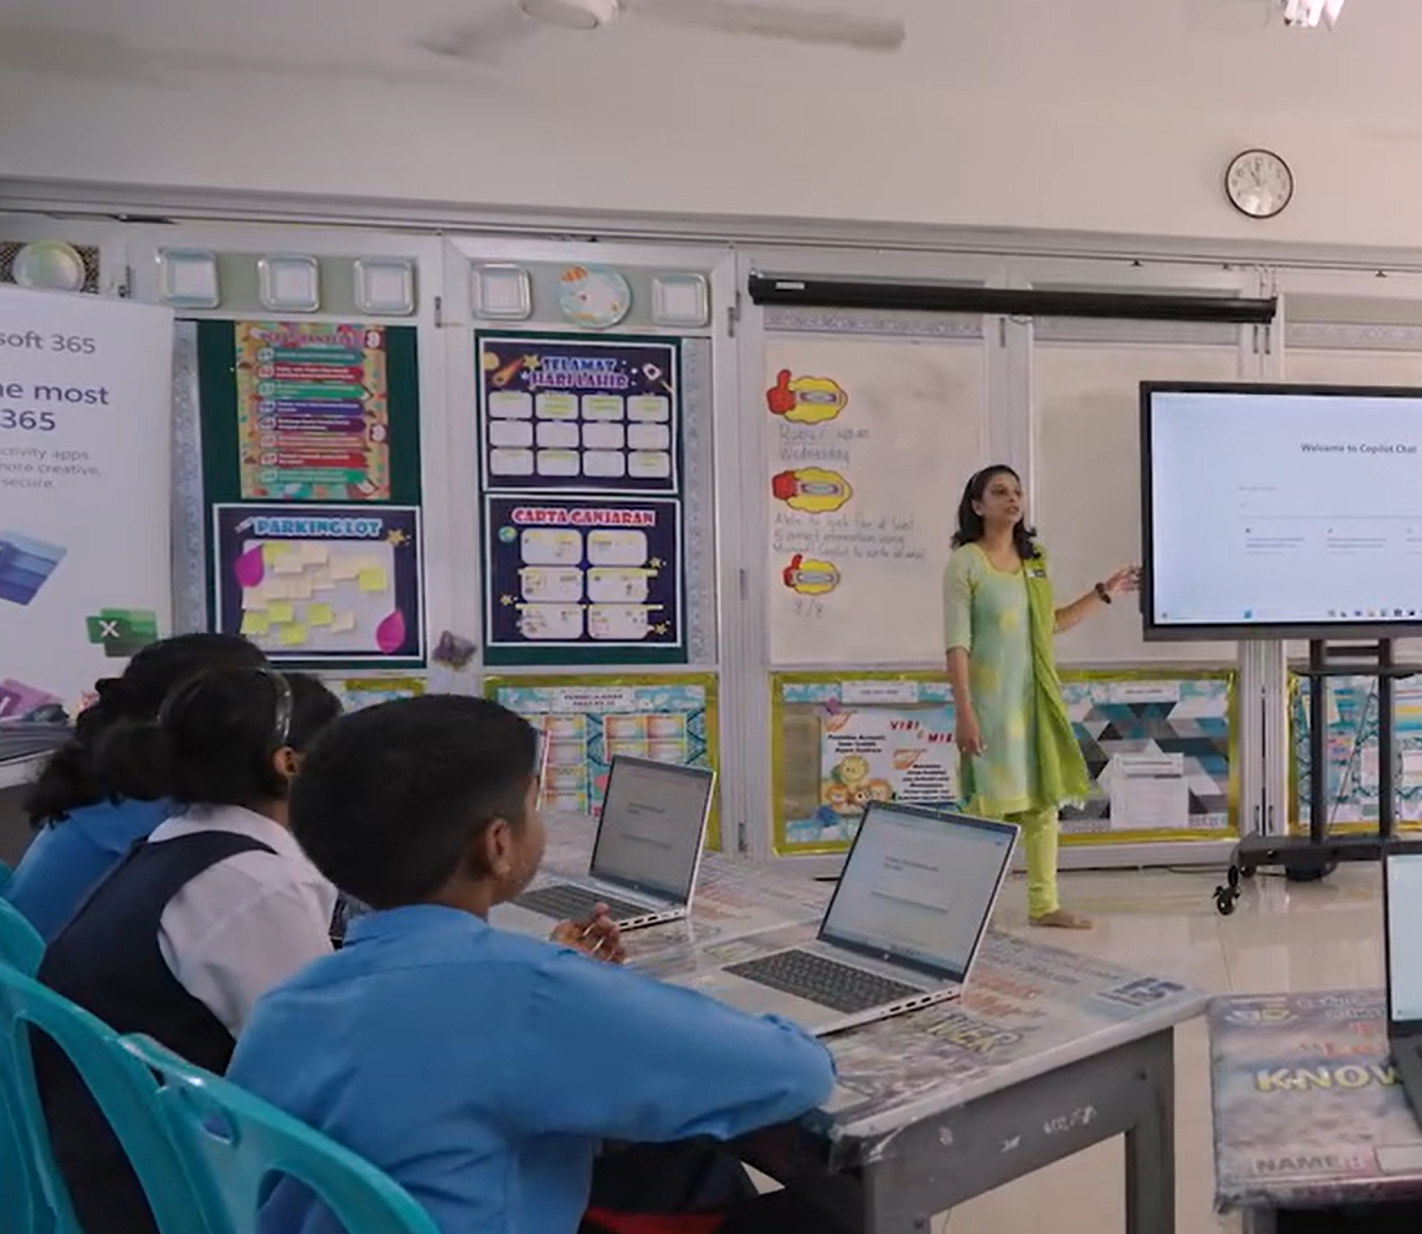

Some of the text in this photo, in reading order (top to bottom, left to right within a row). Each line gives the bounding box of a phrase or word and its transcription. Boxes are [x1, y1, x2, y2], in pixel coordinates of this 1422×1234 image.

[52, 334, 96, 354] 365
[542, 356, 617, 373] SELAMAT
[530, 371, 629, 389] HARI LAHIR
[0, 382, 109, 405] e most
[1, 408, 55, 431] 365
[52, 450, 89, 461] apps
[1301, 442, 1418, 455] Welcome to Copilot Chat
[512, 507, 656, 526] CARTA GANJARAN
[254, 517, 382, 537] PARKING LOT
